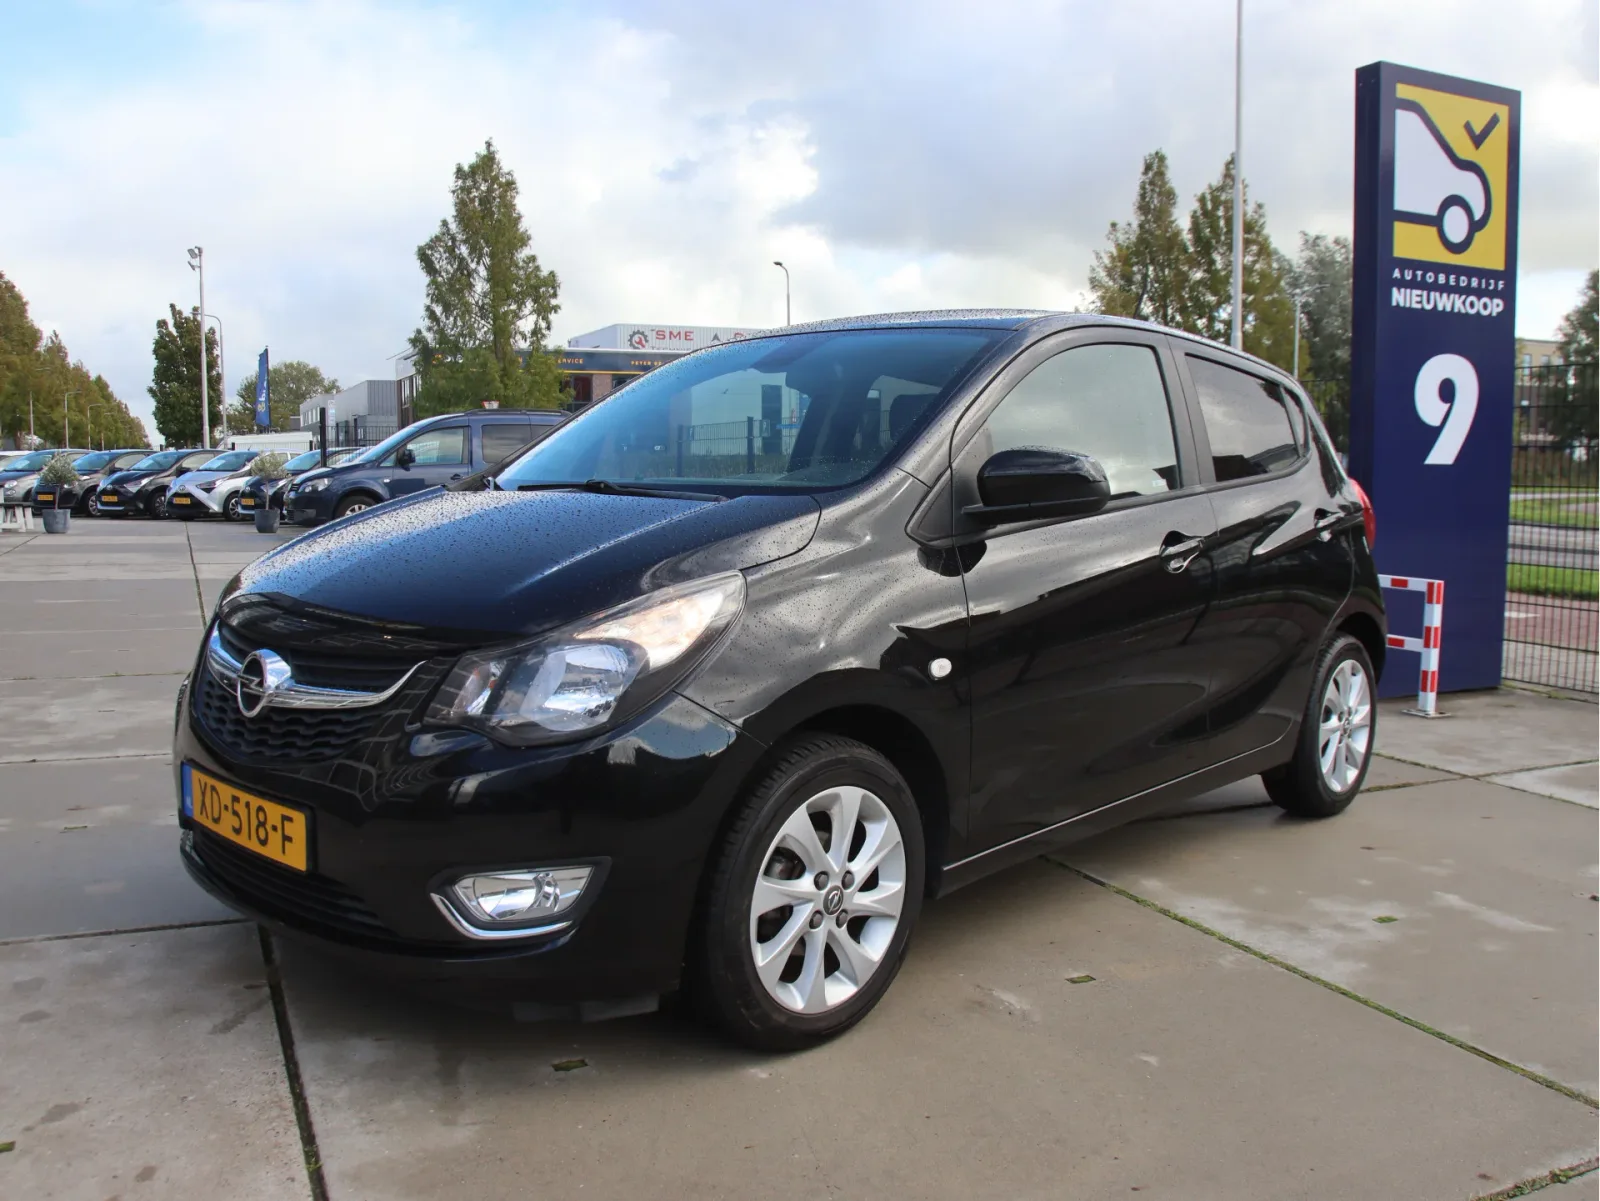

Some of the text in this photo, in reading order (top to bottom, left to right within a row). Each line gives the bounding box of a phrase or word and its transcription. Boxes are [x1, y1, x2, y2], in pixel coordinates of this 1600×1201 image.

[1392, 268, 1505, 291] AUTOBEDRIJF
[1391, 287, 1504, 317] NIEUWKOOP
[655, 329, 694, 341] SME
[556, 357, 585, 365] ERVICE
[1414, 353, 1479, 465] 9
[198, 778, 294, 856] XD-518-F
